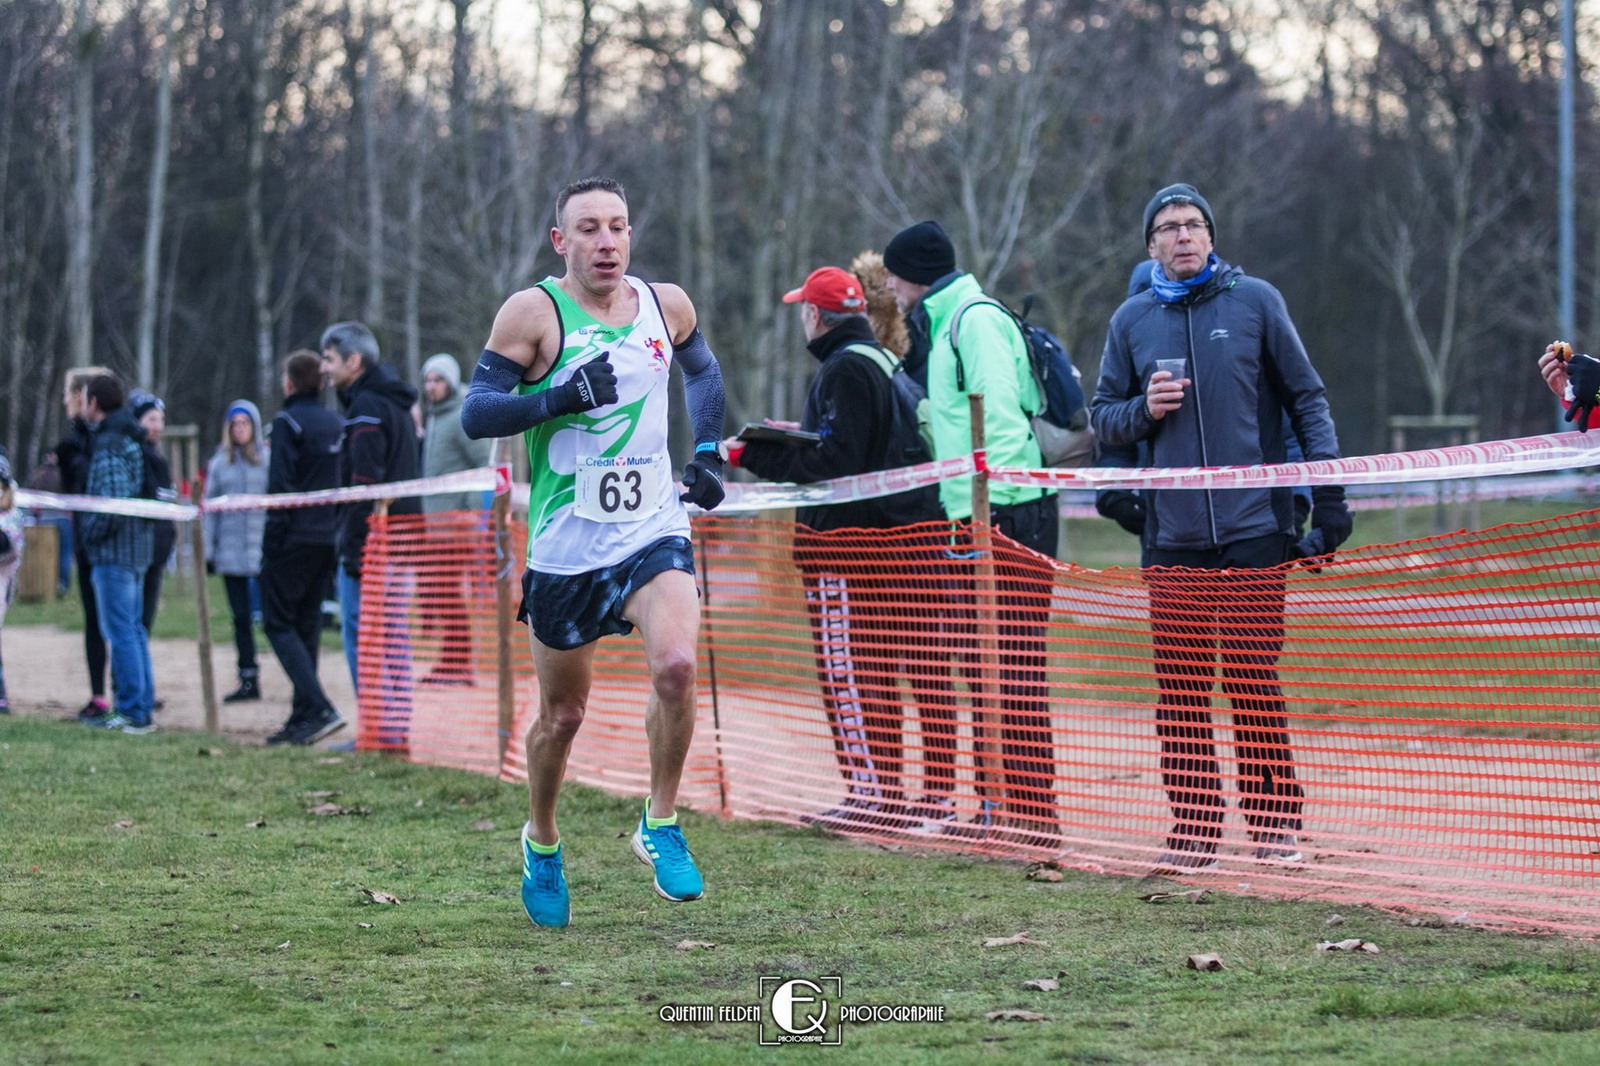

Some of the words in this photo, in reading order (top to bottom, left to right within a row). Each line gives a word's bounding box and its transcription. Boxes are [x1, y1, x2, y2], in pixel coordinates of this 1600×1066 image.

[576, 380, 590, 402] GORE
[585, 457, 615, 467] Crédit
[626, 456, 653, 466] Mutuel
[599, 470, 642, 513] 63
